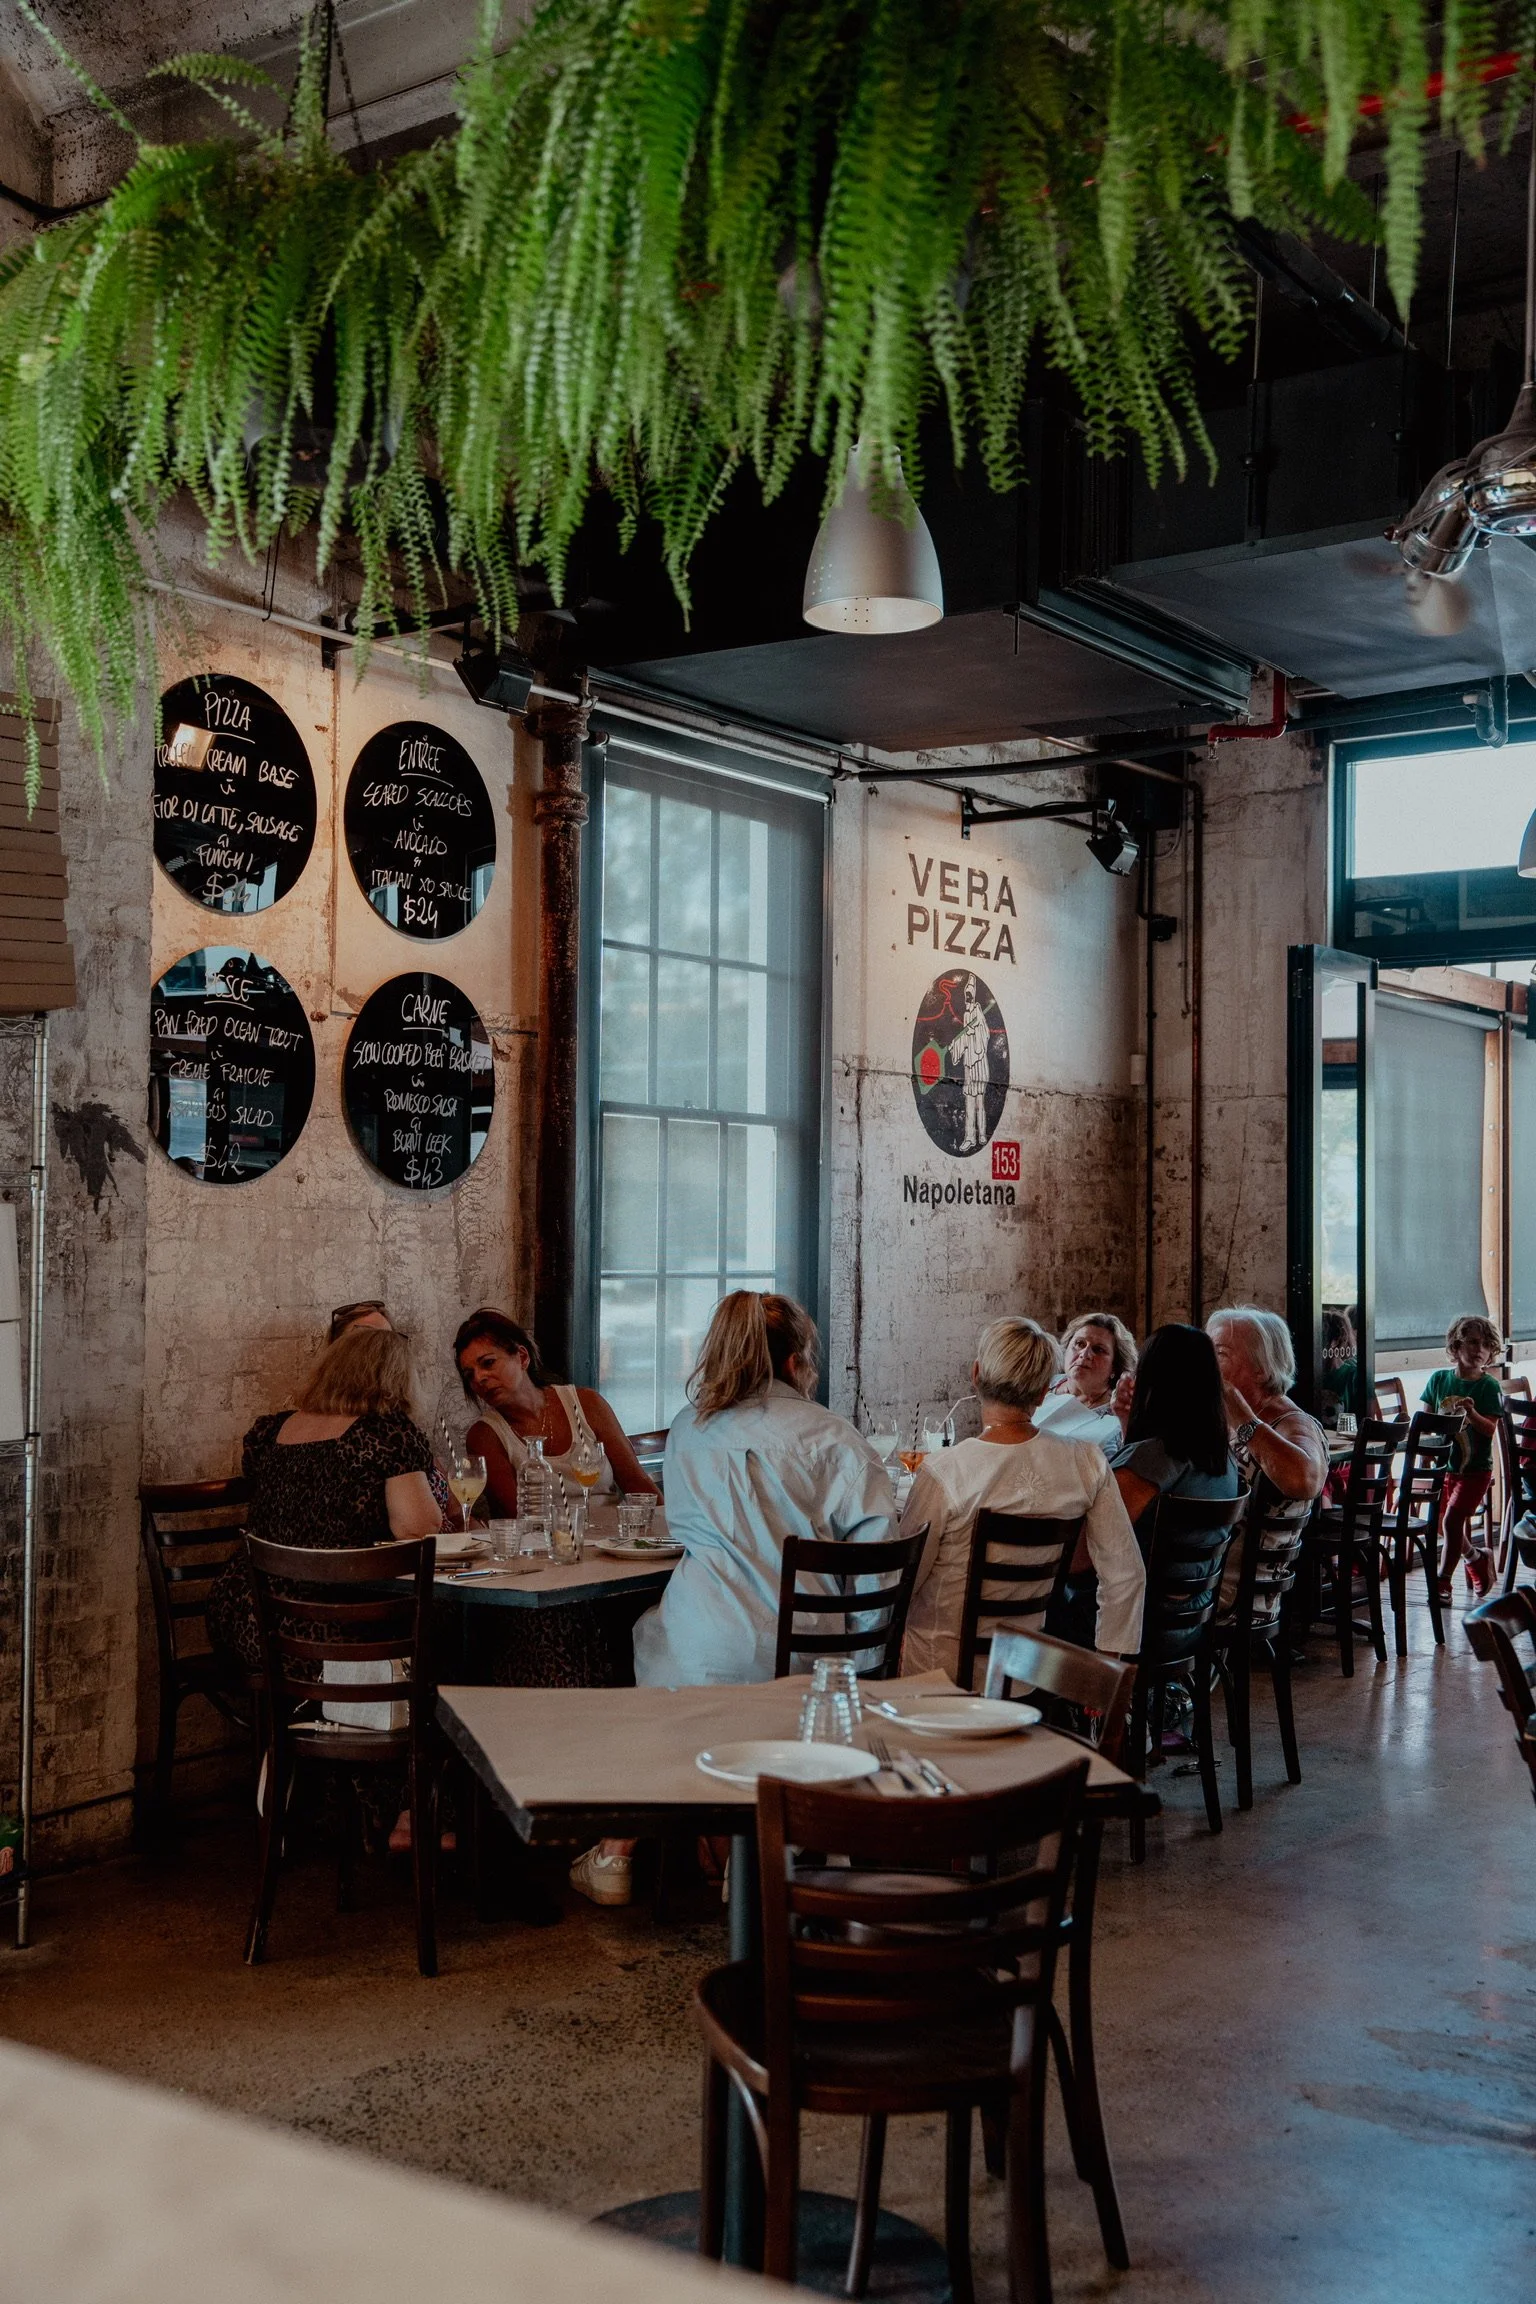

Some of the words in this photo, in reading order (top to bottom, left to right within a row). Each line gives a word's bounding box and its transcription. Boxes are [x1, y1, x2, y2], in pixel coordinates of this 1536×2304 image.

[204, 691, 252, 731] PIZZA
[152, 742, 200, 768] TRUFF
[206, 748, 247, 777] CREAM
[258, 760, 300, 789] BASE
[398, 740, 447, 773] ENTREE
[362, 781, 409, 807] SEARED
[415, 787, 473, 817] SCALLOPS
[152, 793, 179, 819] FIOR
[182, 799, 199, 822] DI
[201, 803, 244, 834] LATTE,
[245, 811, 304, 842] SAUSAGE
[194, 843, 254, 873] FUNGHI
[394, 829, 448, 855] AVOCADO
[371, 869, 413, 890] ITALIAN
[418, 877, 436, 894] XO
[437, 881, 472, 902] SAUCE
[908, 853, 1017, 918] VERA
[403, 894, 439, 929] $24
[907, 903, 1017, 965] PIZZA
[401, 993, 452, 1026] CARNE
[154, 1008, 181, 1037] PAN
[184, 1009, 219, 1037] FRIED
[223, 1017, 262, 1043] OCEAN
[264, 1025, 304, 1051] TROUT
[352, 1040, 381, 1069] SLOW
[424, 1042, 448, 1069] BEEF
[168, 1058, 211, 1080] CREME
[219, 1062, 276, 1087] FRAICHE
[231, 1106, 274, 1127] SALAD
[384, 1088, 431, 1114] ROMESCO
[431, 1094, 458, 1118] SALSA
[199, 1137, 246, 1177] $42
[392, 1129, 423, 1153] BURNT
[425, 1132, 453, 1157] LEEK
[403, 1155, 444, 1189] $43
[994, 1146, 1017, 1176] 153
[903, 1174, 1016, 1209] Napoletana
